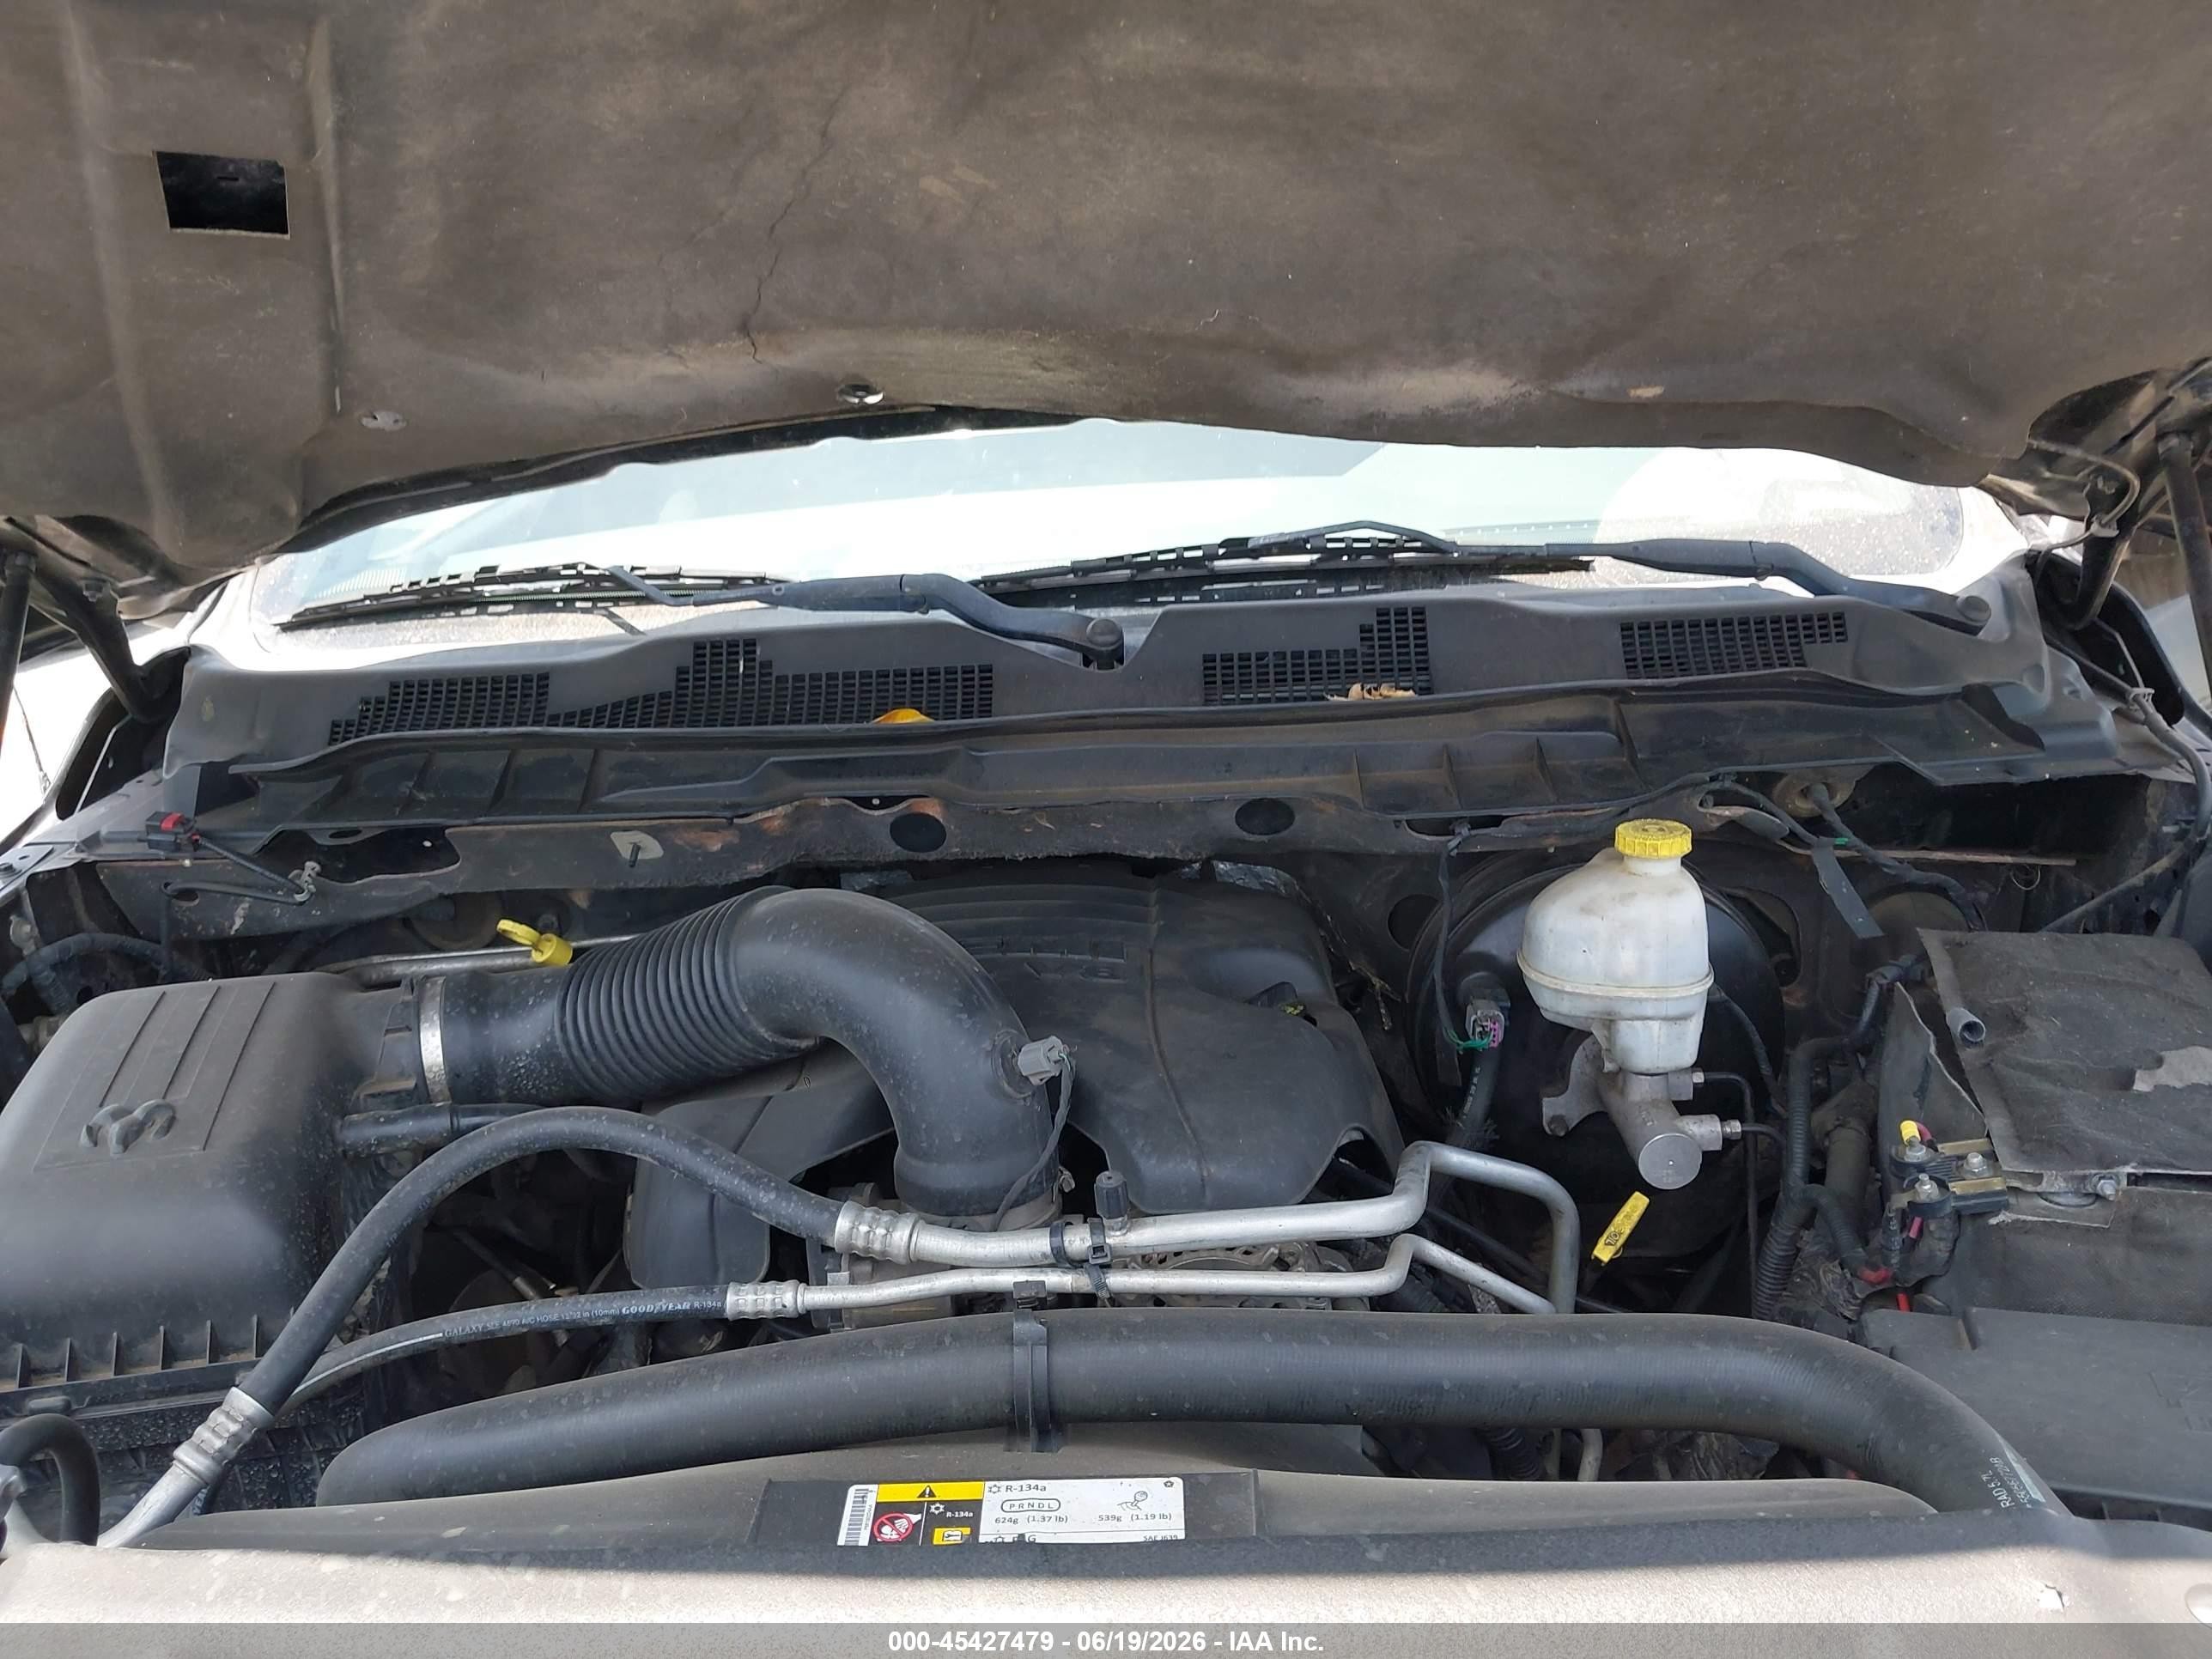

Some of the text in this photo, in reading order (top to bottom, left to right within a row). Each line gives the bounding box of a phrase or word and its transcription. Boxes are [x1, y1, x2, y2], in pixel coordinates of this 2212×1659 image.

[444, 1323, 483, 1338] GALAXY
[537, 1314, 559, 1324] HOSE
[591, 1307, 620, 1317] (10mm)
[693, 1300, 722, 1310] R-134a
[1005, 1484, 1047, 1492] R-134a
[1992, 1487, 2015, 1509] RAD
[994, 1515, 1068, 1525] 624g (1.37 lb)
[1098, 1514, 1122, 1522] 539g
[1158, 1513, 1172, 1522] lb)
